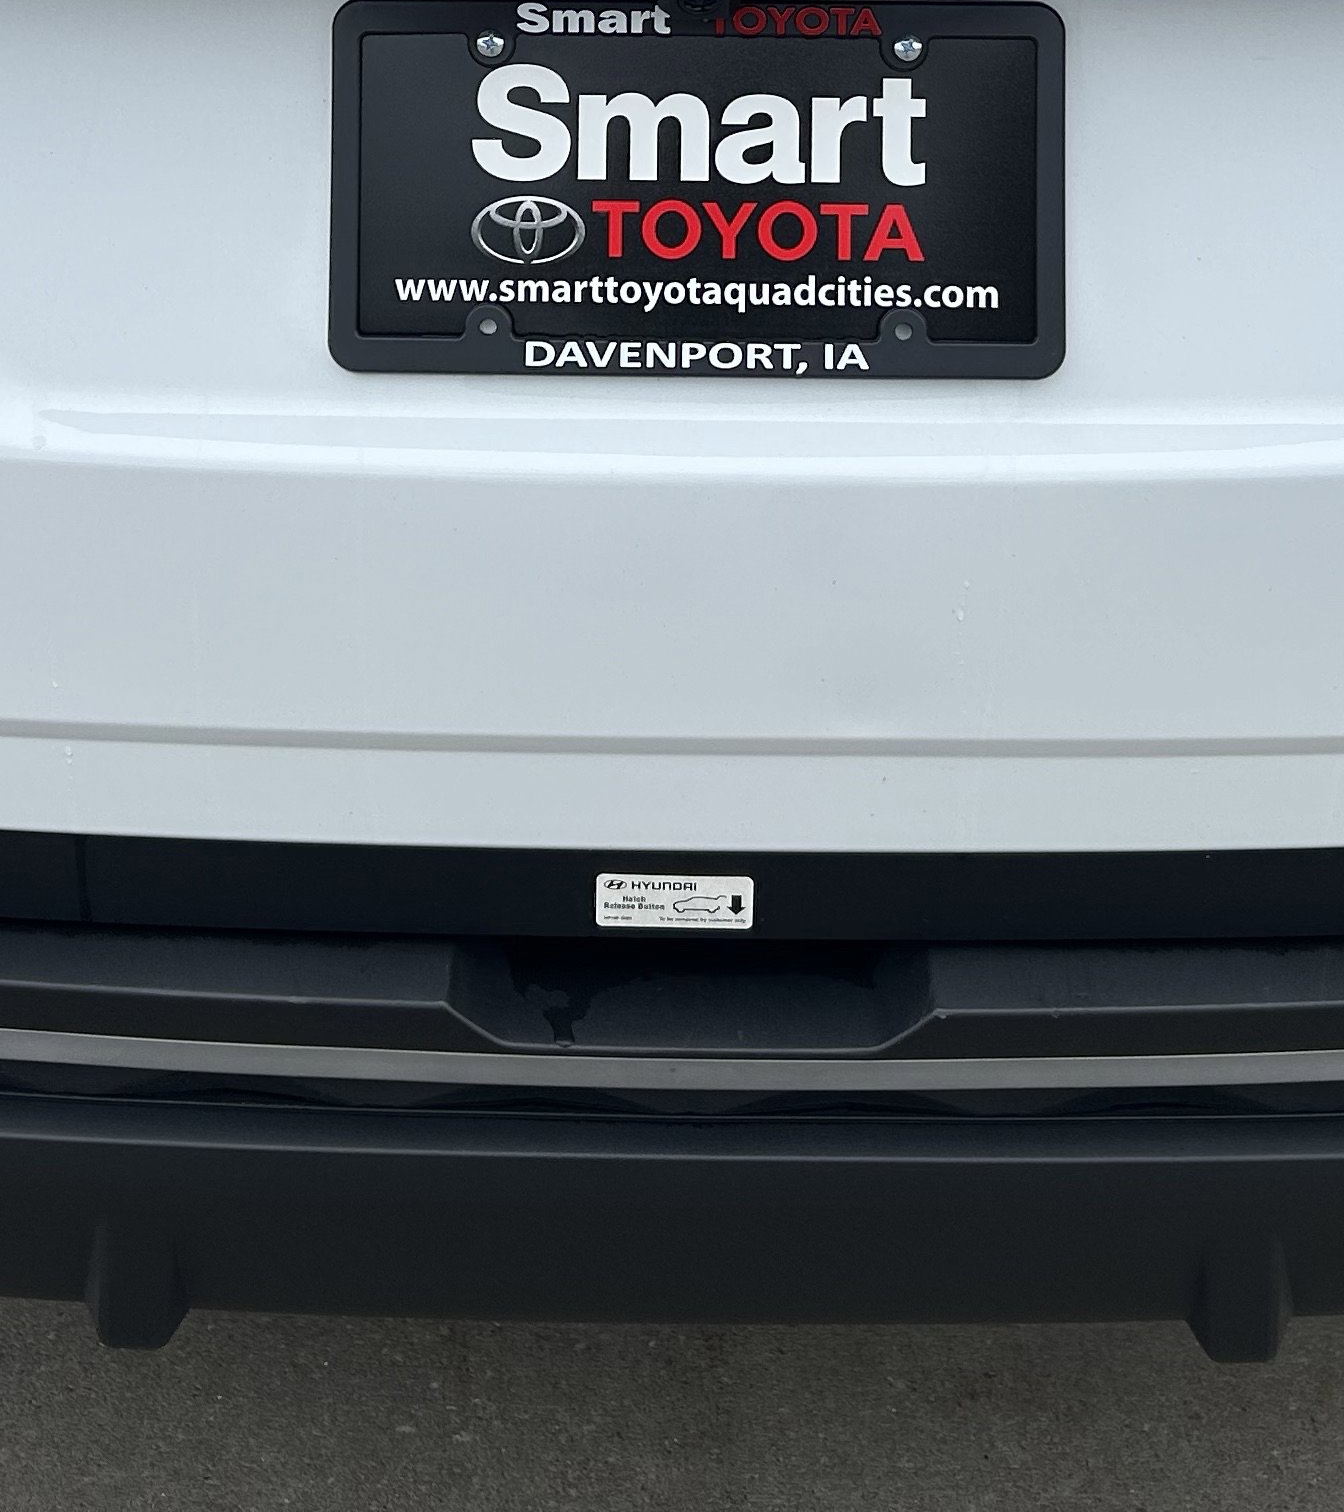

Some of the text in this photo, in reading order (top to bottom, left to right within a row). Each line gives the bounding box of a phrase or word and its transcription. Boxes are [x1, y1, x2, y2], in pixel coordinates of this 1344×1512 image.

[516, 2, 671, 35] Smart
[471, 63, 927, 186] Smart
[591, 199, 925, 262] TOYOTA
[394, 274, 1000, 312] www.smarttoyotaquadcities.com
[523, 340, 870, 376] DAVENPORT, IA
[631, 881, 697, 891] HYUNDAI
